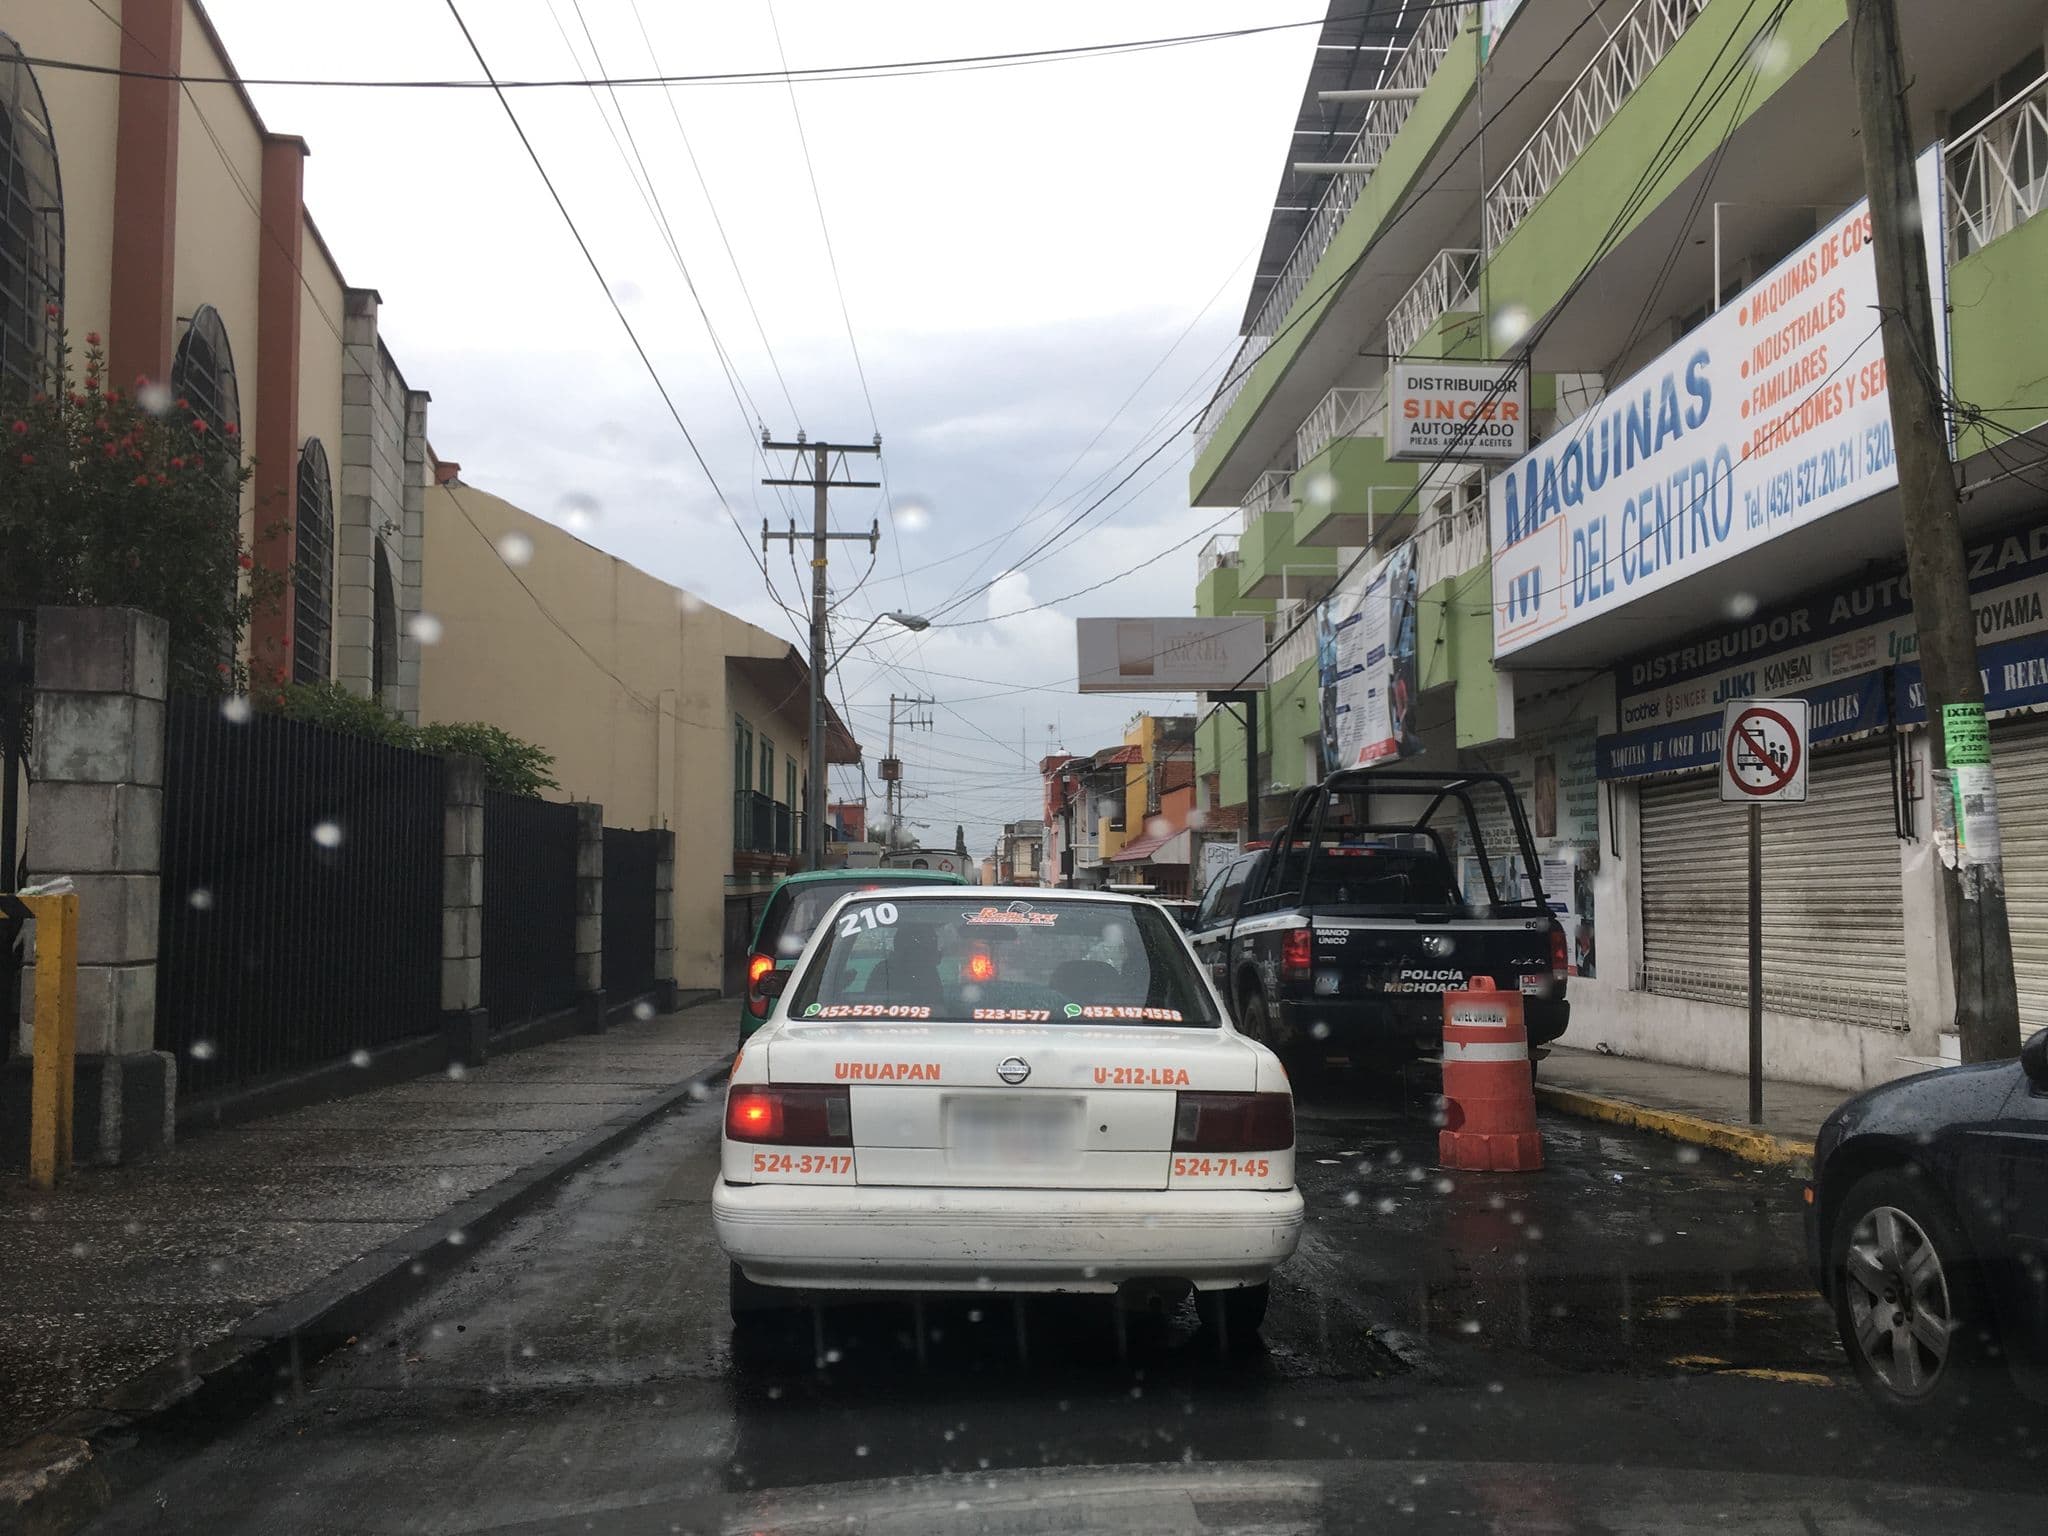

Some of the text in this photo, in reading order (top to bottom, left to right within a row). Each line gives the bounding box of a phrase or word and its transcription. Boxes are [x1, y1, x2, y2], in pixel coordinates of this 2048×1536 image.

[1752, 212, 1873, 326] MAQUINAS DE COS
[1752, 287, 1846, 376] INDUSTRIALES
[1407, 377, 1518, 392] DISTRIBUIDOR
[1752, 344, 1828, 416] FAMILIARES
[1403, 398, 1520, 421] SINGER
[1753, 357, 1888, 460] REFACCIONES Y SER
[1410, 422, 1514, 437] AUTORIZADO
[1480, 439, 1512, 447] ACEITES
[1505, 347, 1712, 550] MAQUINAS
[1744, 484, 1764, 531] Tel.
[1766, 470, 1794, 534] (452)
[1797, 437, 1854, 508] 527.20.21
[1866, 420, 1896, 476] 520.
[1573, 442, 1733, 608] DEL CENTRO
[1632, 607, 1811, 686] DISTRIBUIDOR
[1764, 654, 1812, 687] KANSAI
[2004, 658, 2048, 691] REFA
[1675, 687, 1706, 711] SINGER
[1713, 671, 1756, 704] JUKI
[1807, 692, 1860, 731] ILIARES
[1669, 735, 1694, 758] COSER
[839, 903, 898, 937] 210
[1401, 969, 1464, 980] POLICÍA
[1384, 981, 1468, 993] MICHOACÁ
[819, 1005, 930, 1018] 452-529-0993
[974, 1009, 1050, 1021] 523-15-77
[834, 1063, 941, 1080] URUAPAN
[1093, 1068, 1190, 1085] U-212-LBA
[753, 1154, 852, 1174] 524-37-17
[1174, 1159, 1269, 1177] 524-71-45
